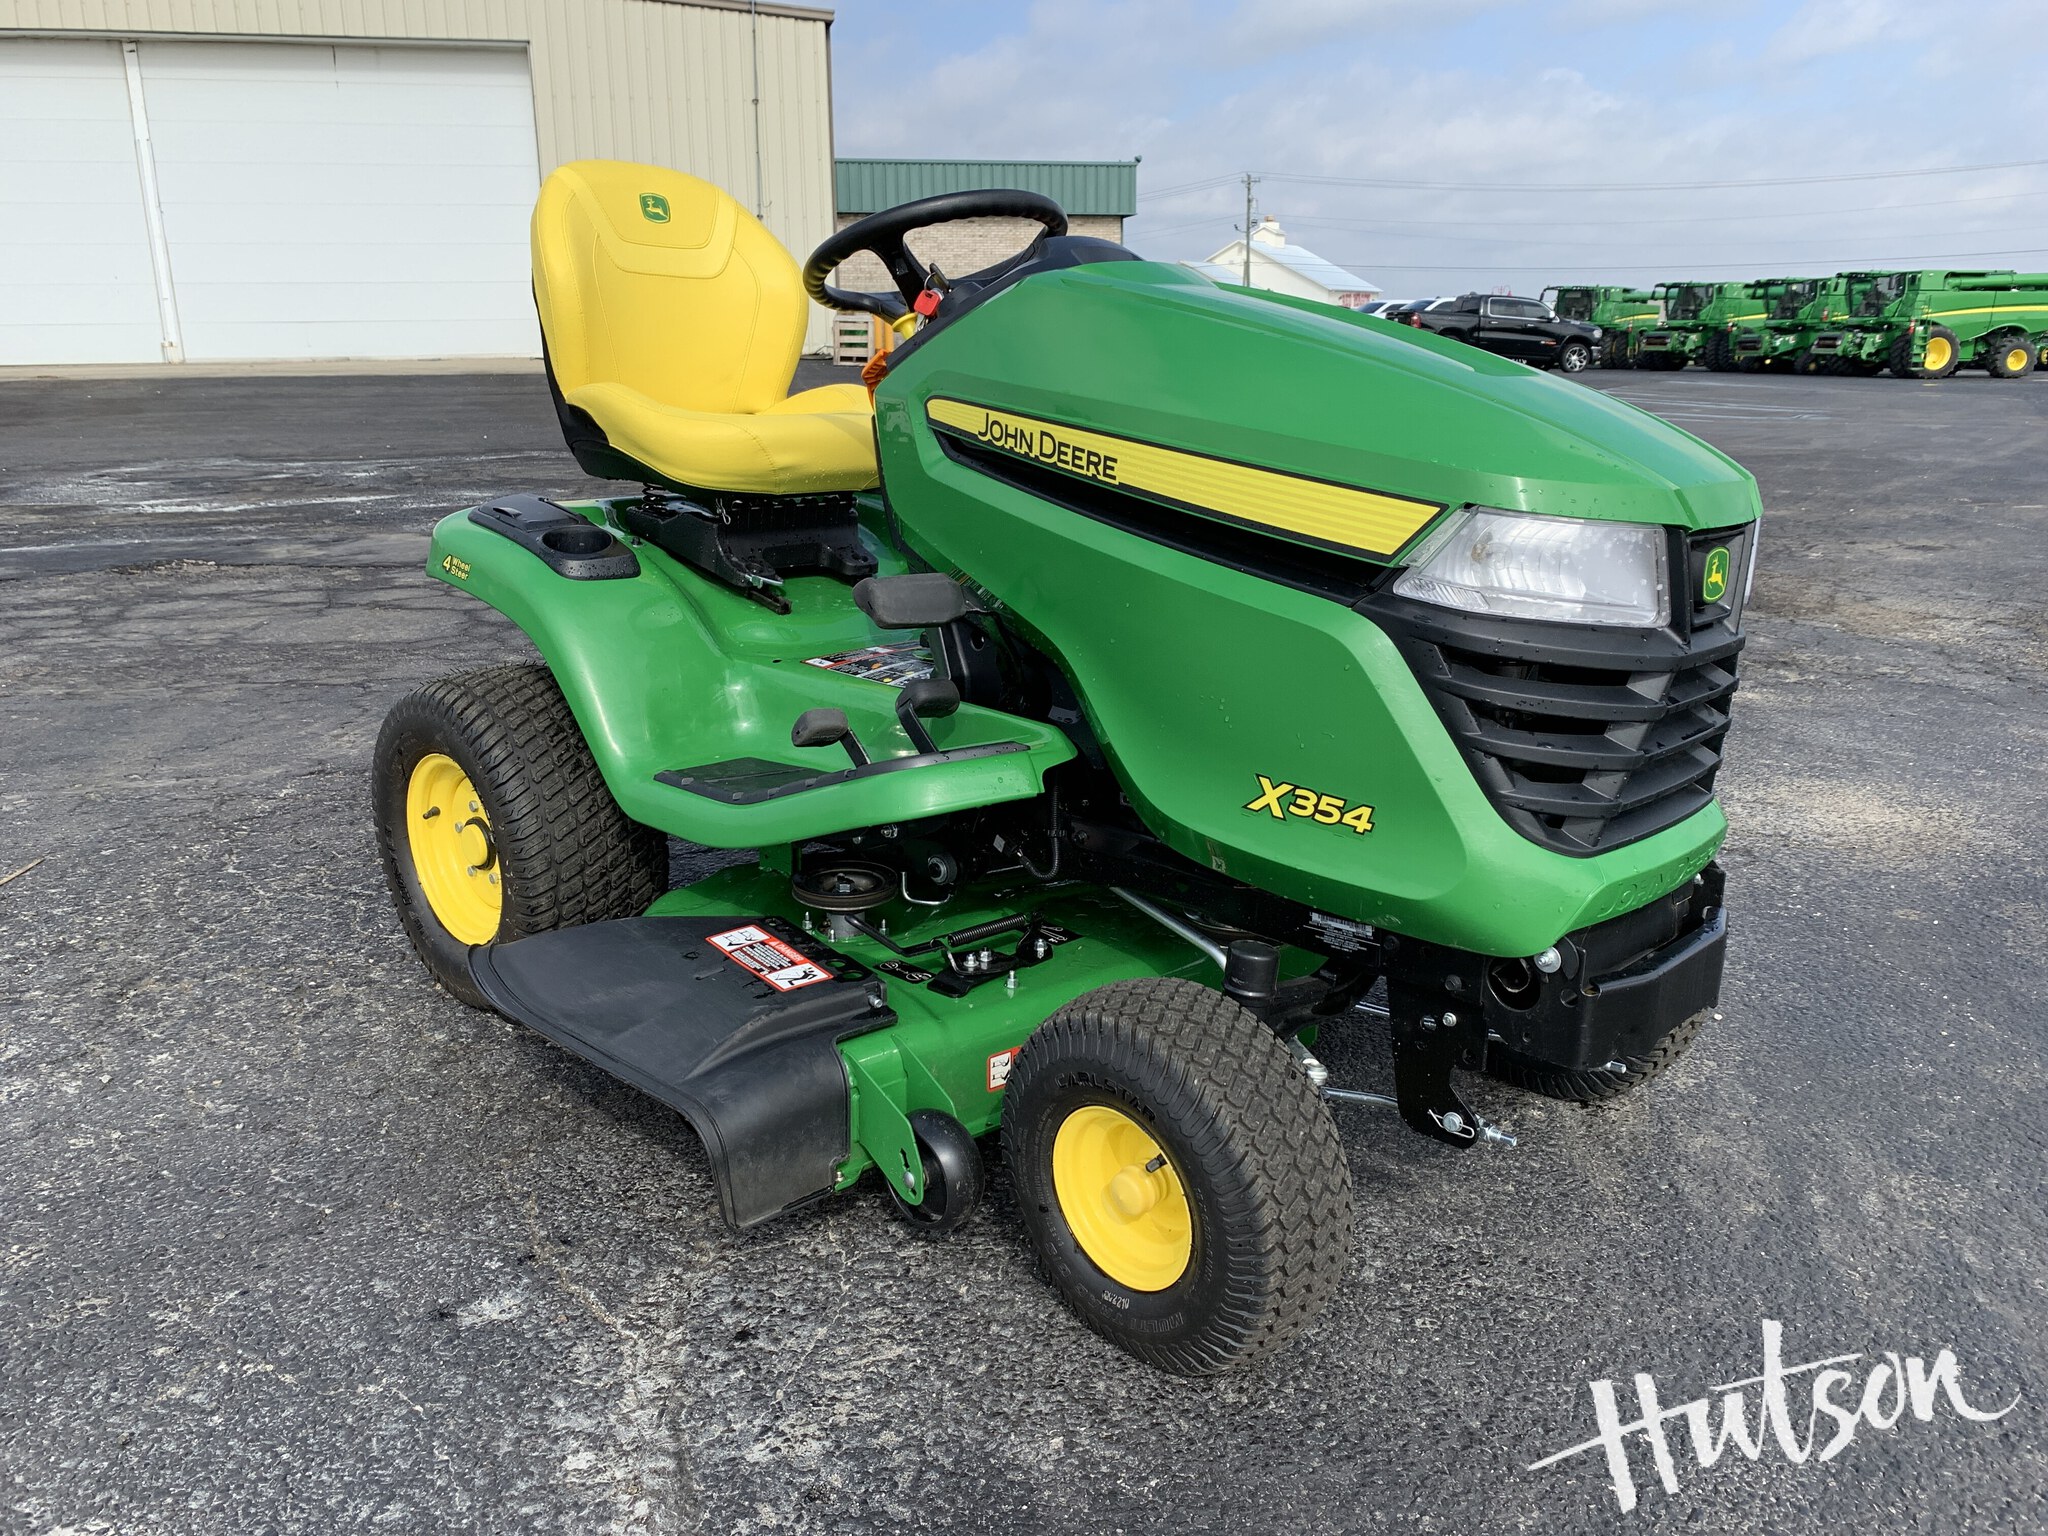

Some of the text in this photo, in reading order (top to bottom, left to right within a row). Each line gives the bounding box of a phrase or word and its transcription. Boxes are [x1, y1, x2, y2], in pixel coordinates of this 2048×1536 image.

[977, 412, 1119, 484] JOHN DEERE
[442, 554, 471, 573] 4 Wheel
[450, 565, 469, 581] Steer
[1241, 772, 1376, 836] X354
[1055, 1071, 1156, 1125] CARLSTAR
